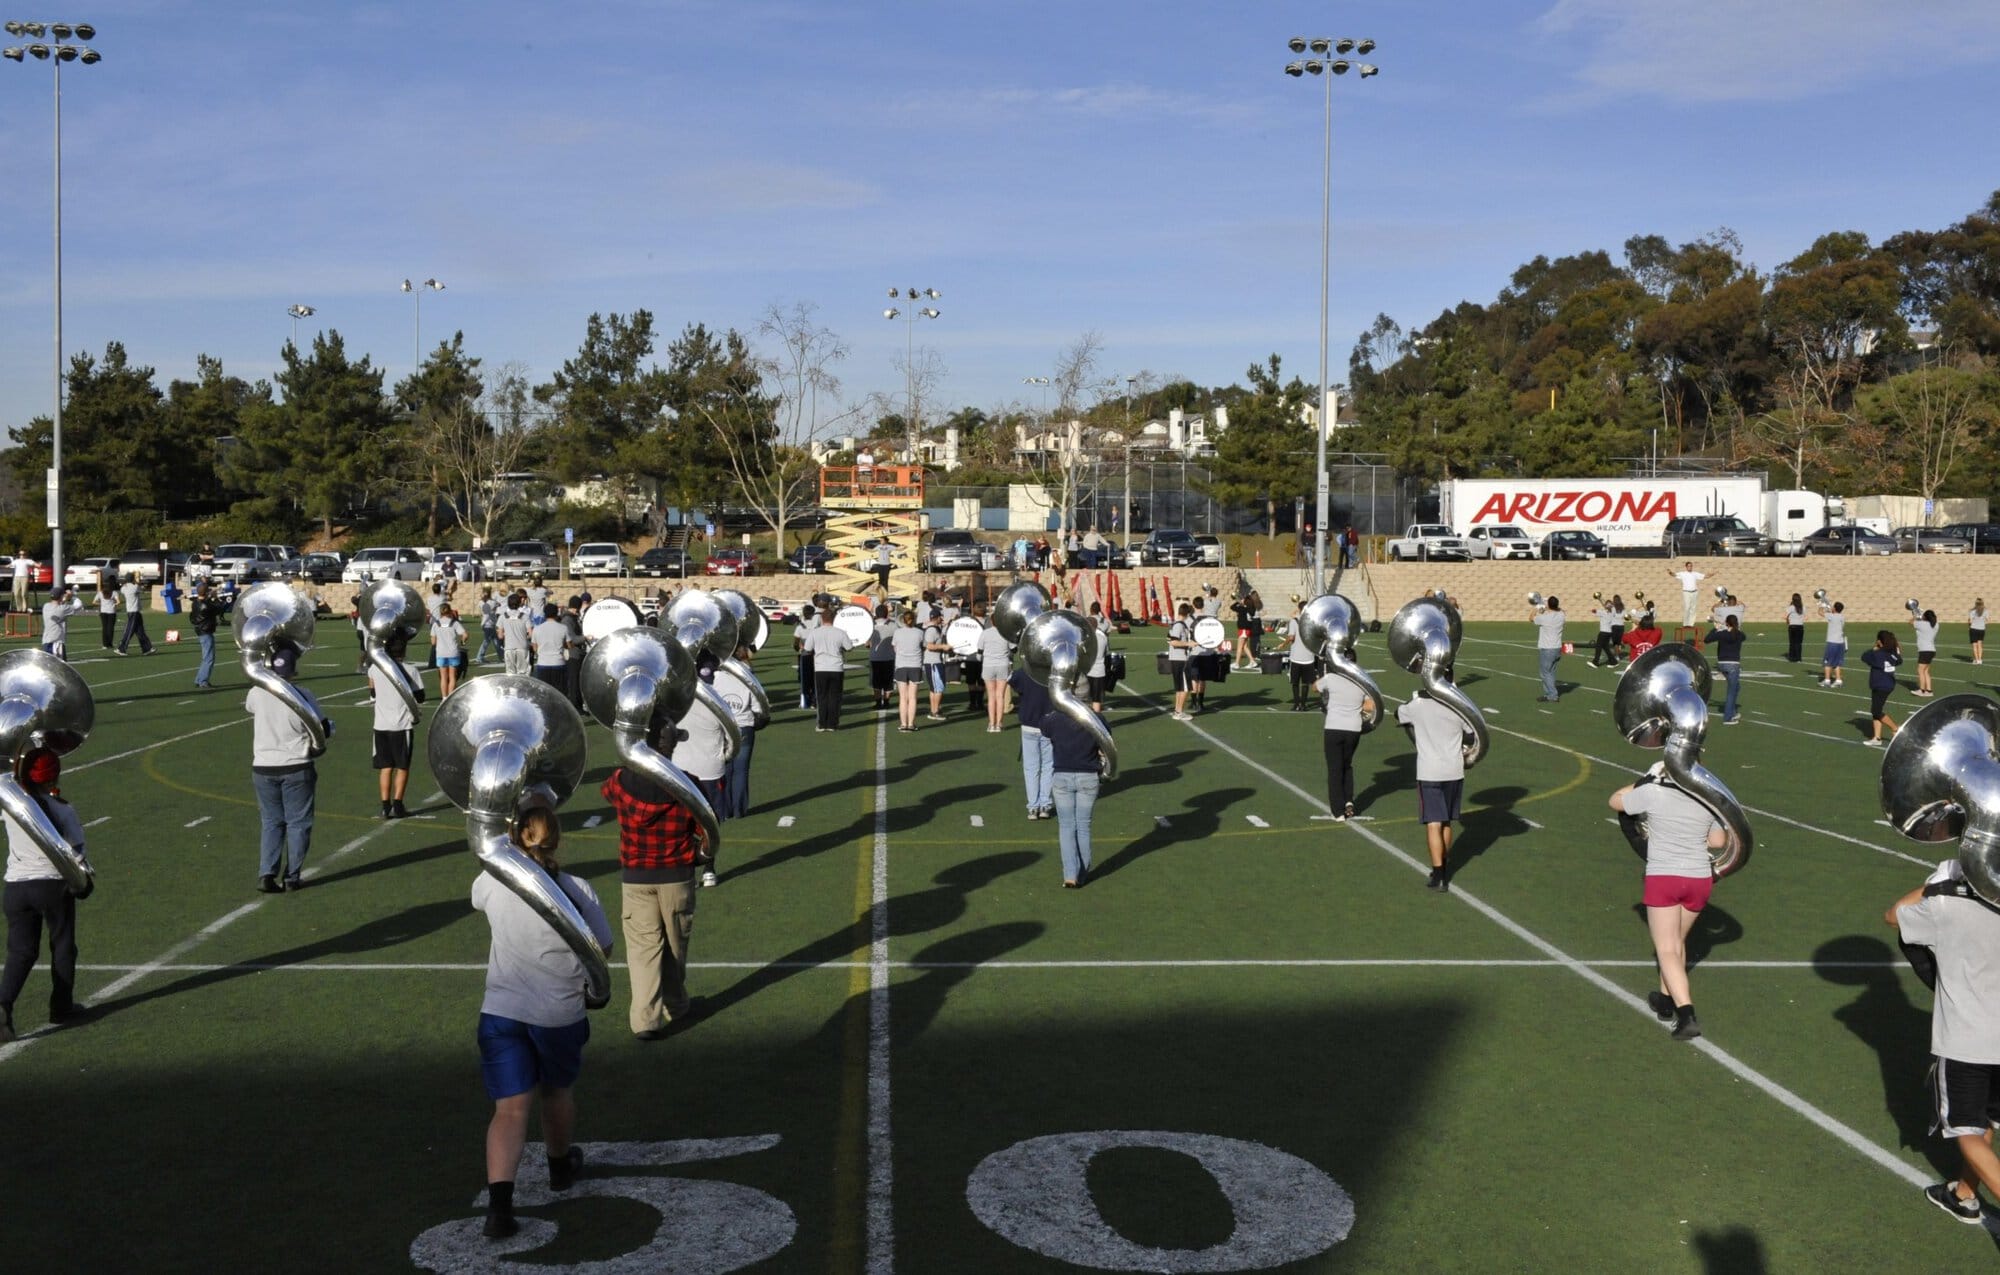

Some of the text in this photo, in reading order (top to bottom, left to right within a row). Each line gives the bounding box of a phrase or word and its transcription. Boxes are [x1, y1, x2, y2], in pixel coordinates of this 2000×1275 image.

[1471, 491, 1677, 524] ARIZONA
[1597, 524, 1631, 532] WILDCATS
[1221, 640, 1232, 651] 40
